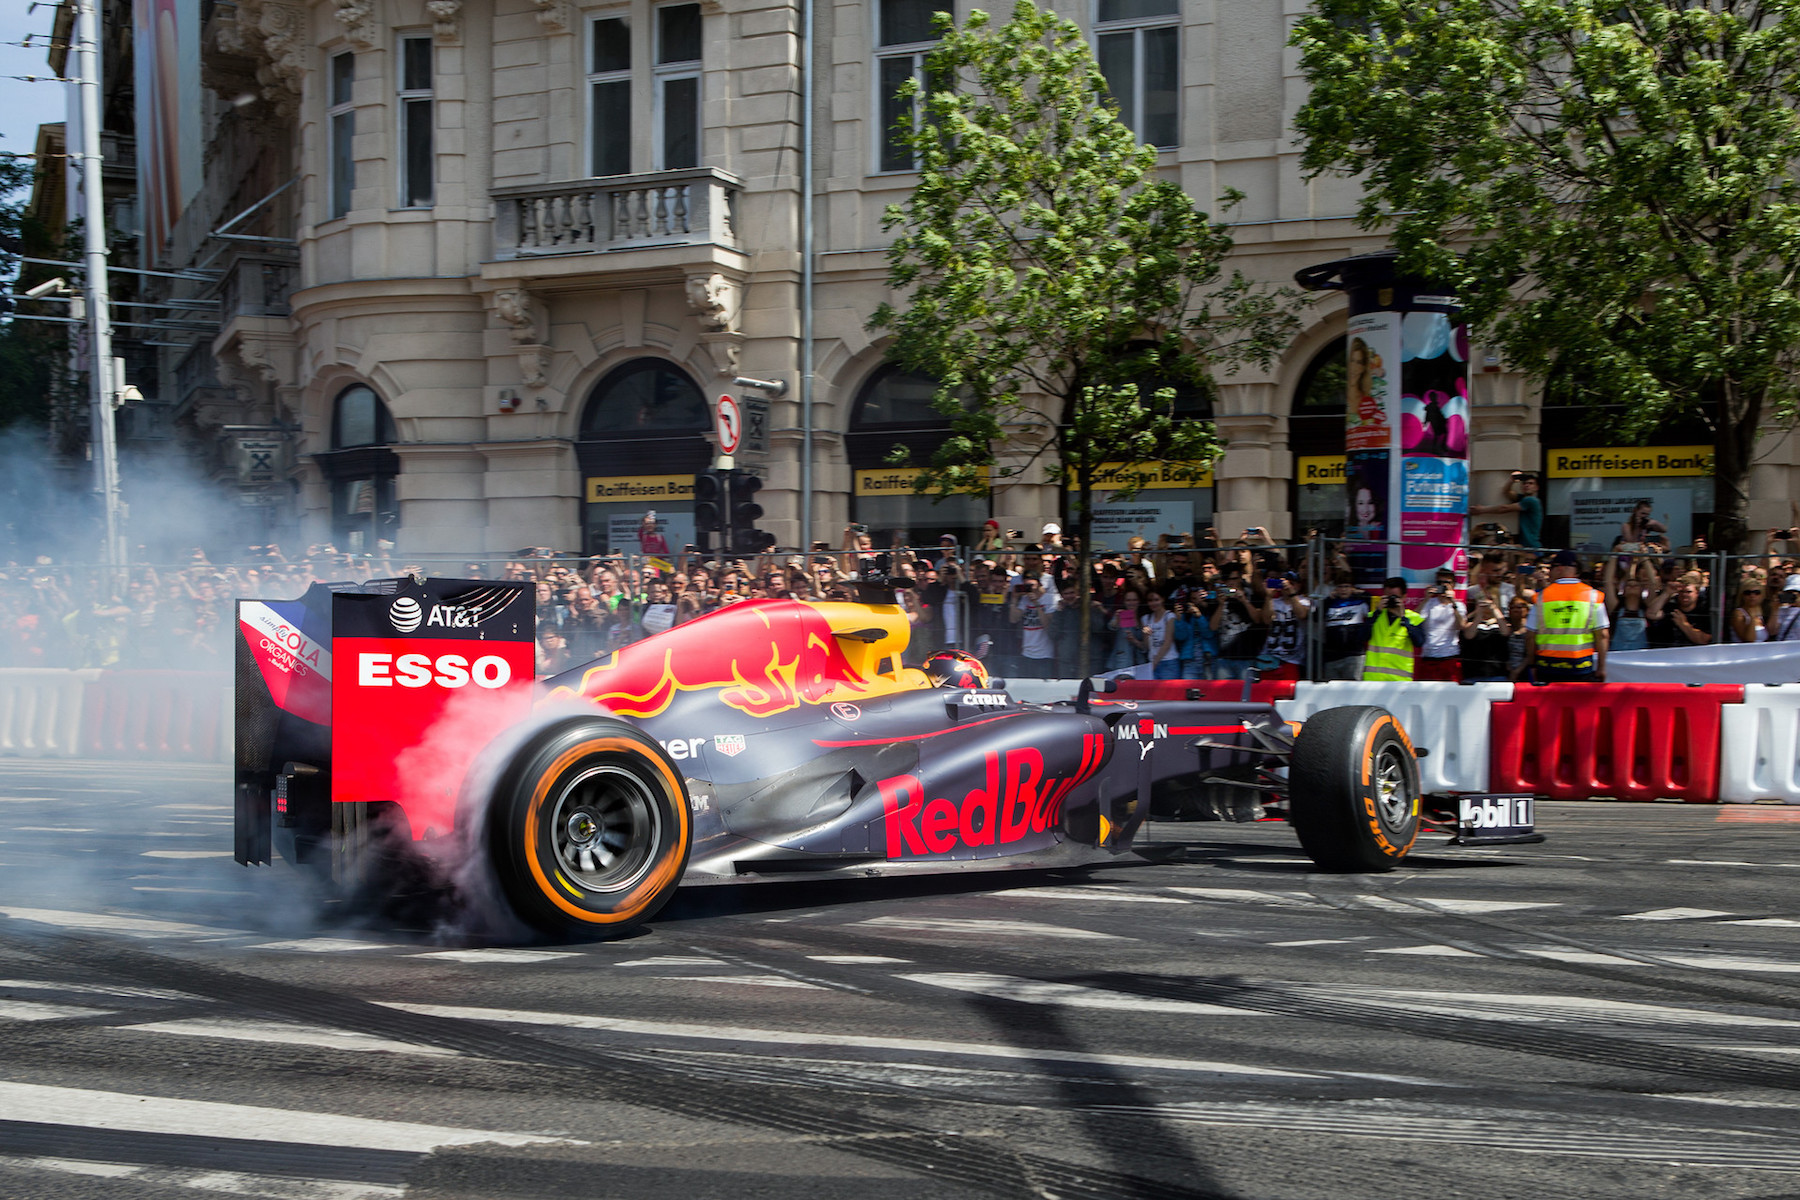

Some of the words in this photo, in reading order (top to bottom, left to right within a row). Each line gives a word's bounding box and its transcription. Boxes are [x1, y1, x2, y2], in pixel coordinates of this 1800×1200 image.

[1557, 454, 1653, 471] Raiffeisen
[1657, 454, 1705, 469] Bank
[596, 482, 666, 497] Raiffeisen
[668, 482, 696, 494] Ban
[259, 616, 288, 638] simply
[427, 605, 483, 628] AT&T
[260, 638, 309, 677] ORGANICS
[275, 625, 320, 668] COLA
[358, 653, 511, 689] ESSO
[1117, 724, 1168, 740] MAIN
[1516, 800, 1528, 824] 1
[1363, 797, 1398, 857] ZERO
